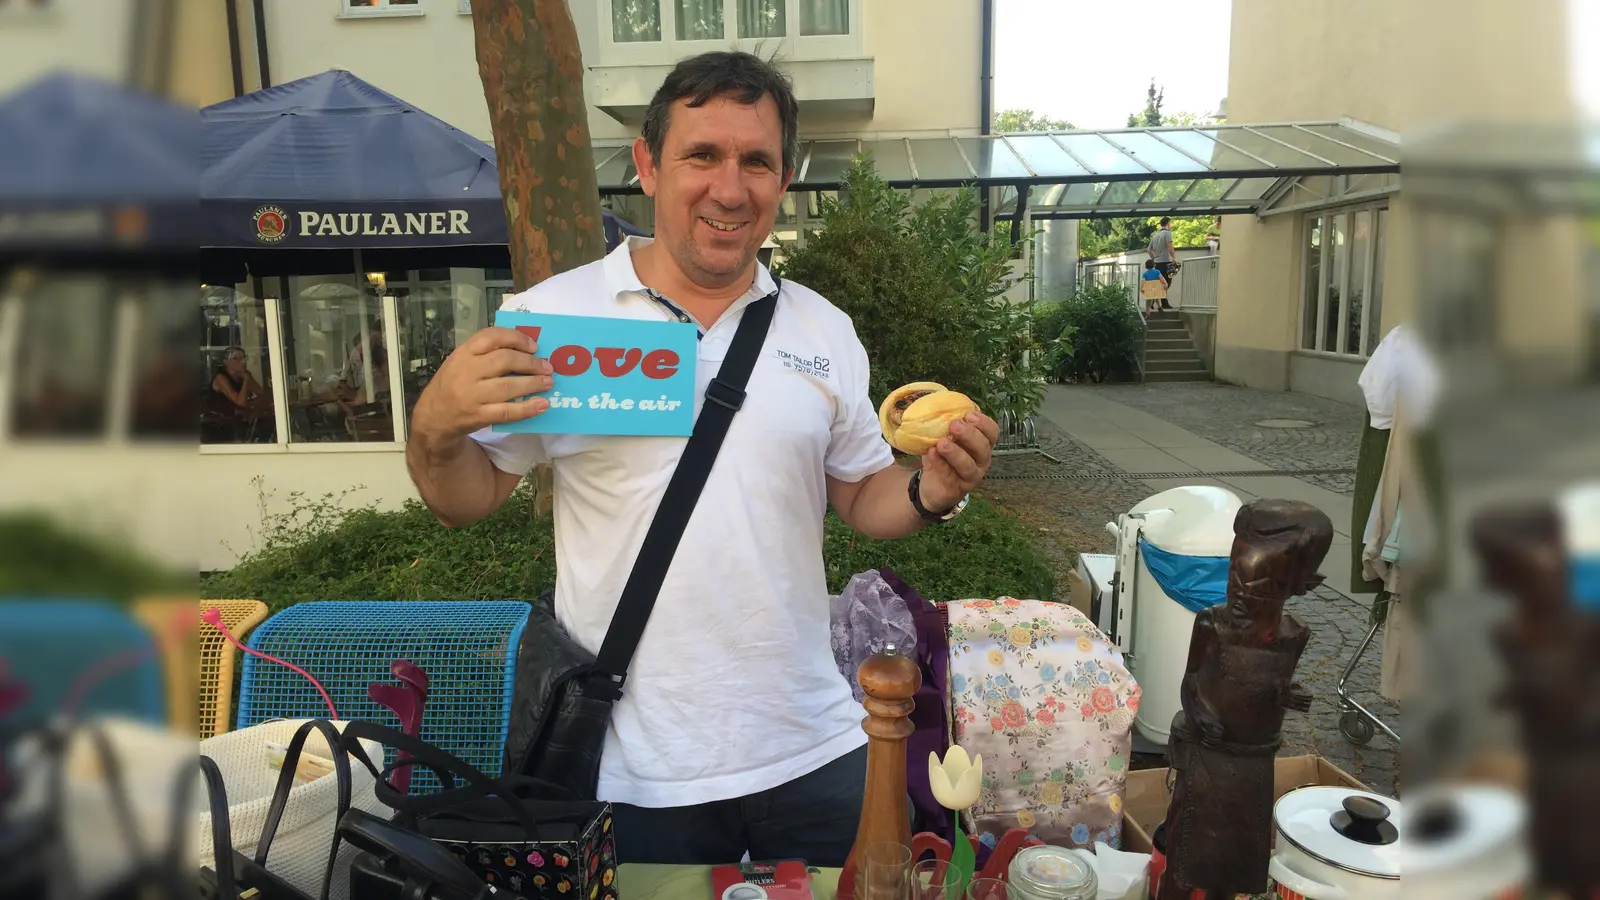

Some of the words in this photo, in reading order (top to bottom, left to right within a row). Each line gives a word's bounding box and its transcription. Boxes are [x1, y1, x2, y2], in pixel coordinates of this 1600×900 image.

[252, 206, 288, 221] PAULANER
[298, 209, 471, 236] PAULANER
[777, 349, 791, 360] TOM
[793, 354, 812, 367] TAILOR
[814, 356, 829, 372] 62
[549, 391, 583, 408] in
[588, 392, 634, 410] the
[638, 395, 681, 411] air
